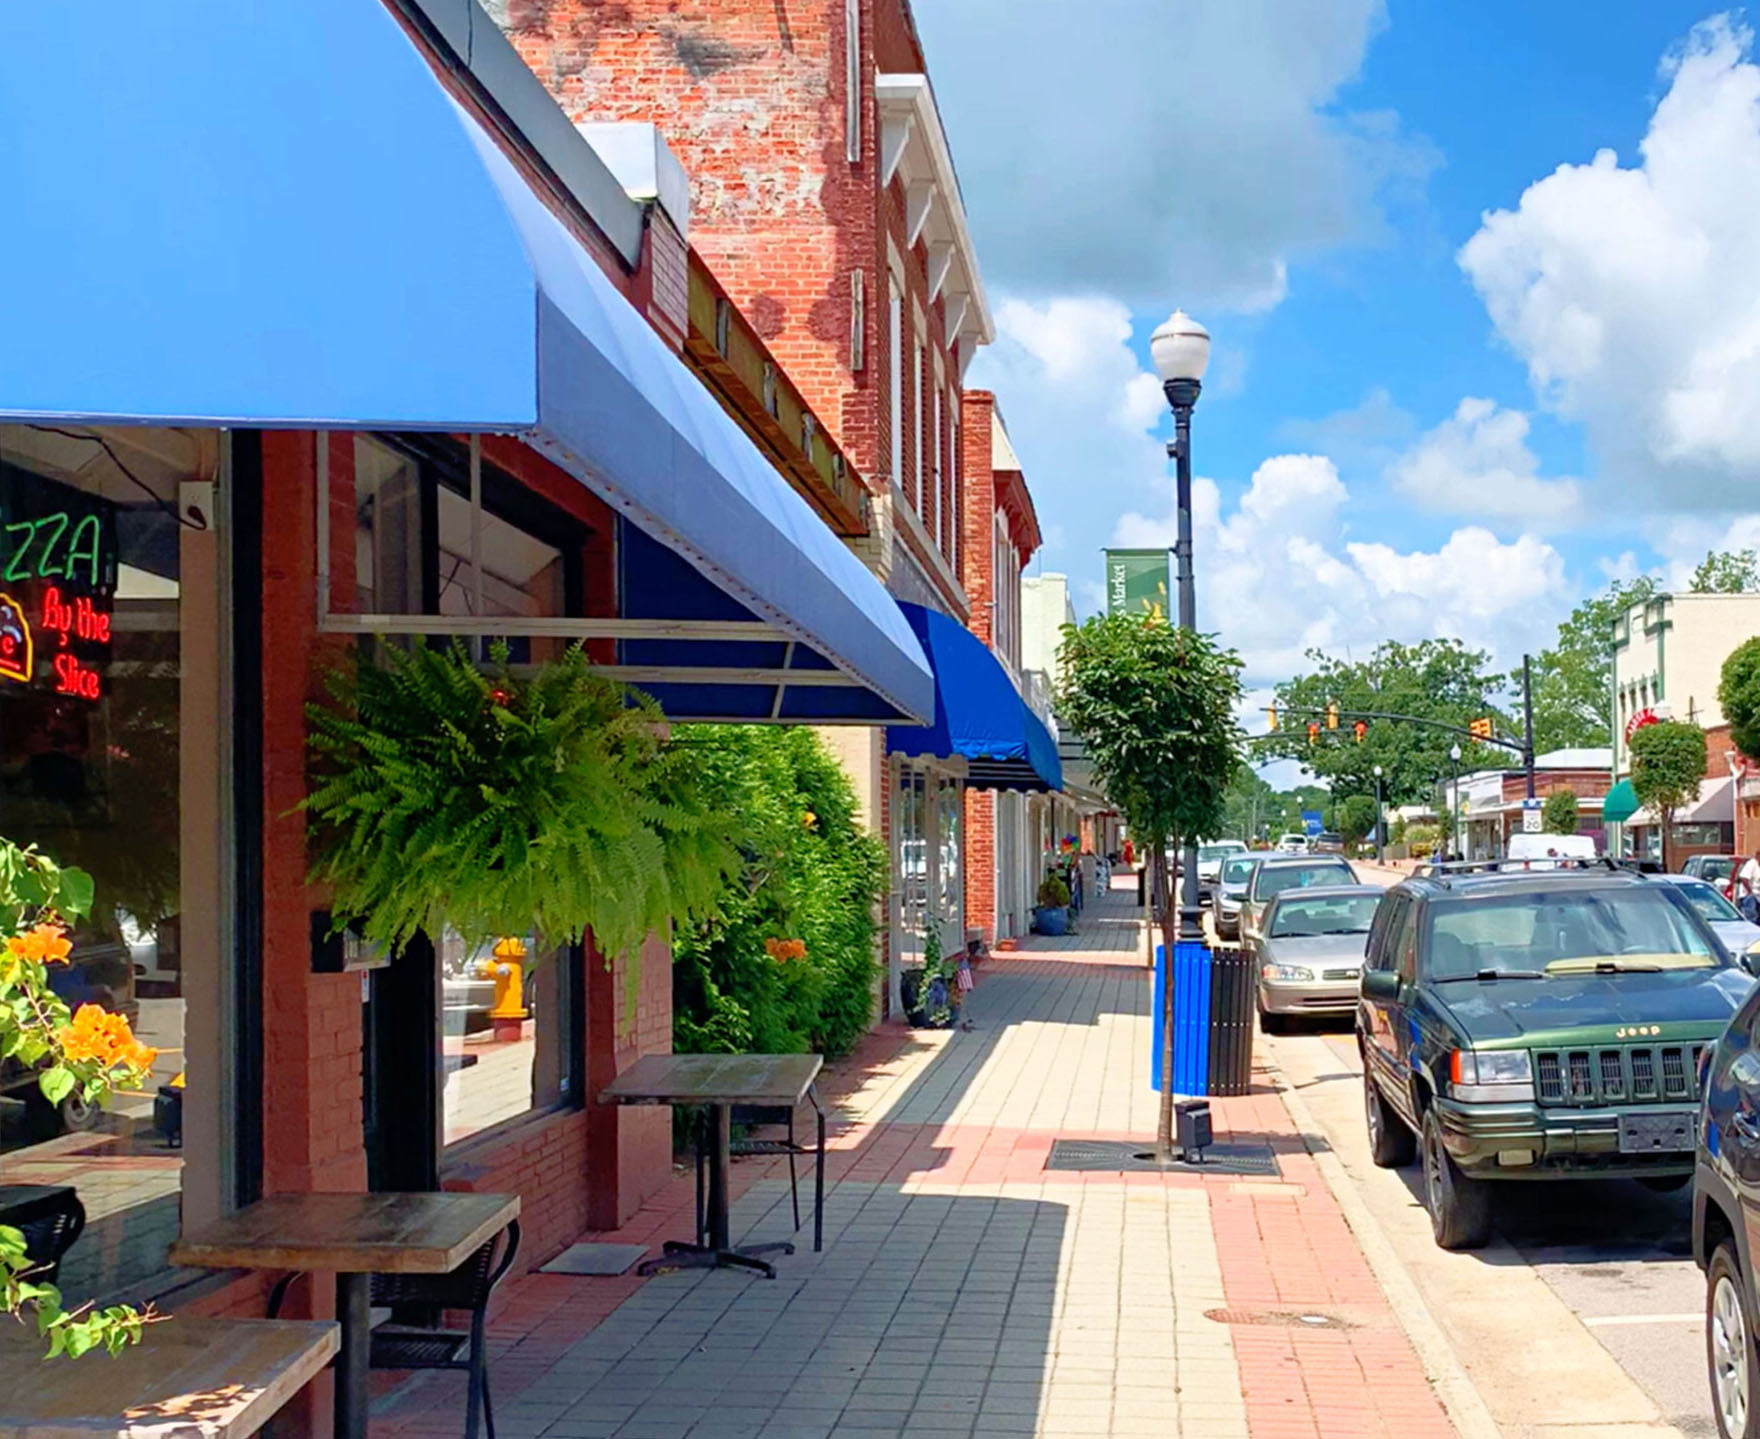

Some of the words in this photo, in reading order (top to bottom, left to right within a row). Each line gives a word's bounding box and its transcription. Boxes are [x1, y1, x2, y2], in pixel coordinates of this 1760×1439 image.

[3, 512, 100, 585] ZZA
[1111, 564, 1126, 606] Market
[42, 587, 72, 646] By
[76, 597, 110, 642] the
[55, 653, 99, 698] Slice
